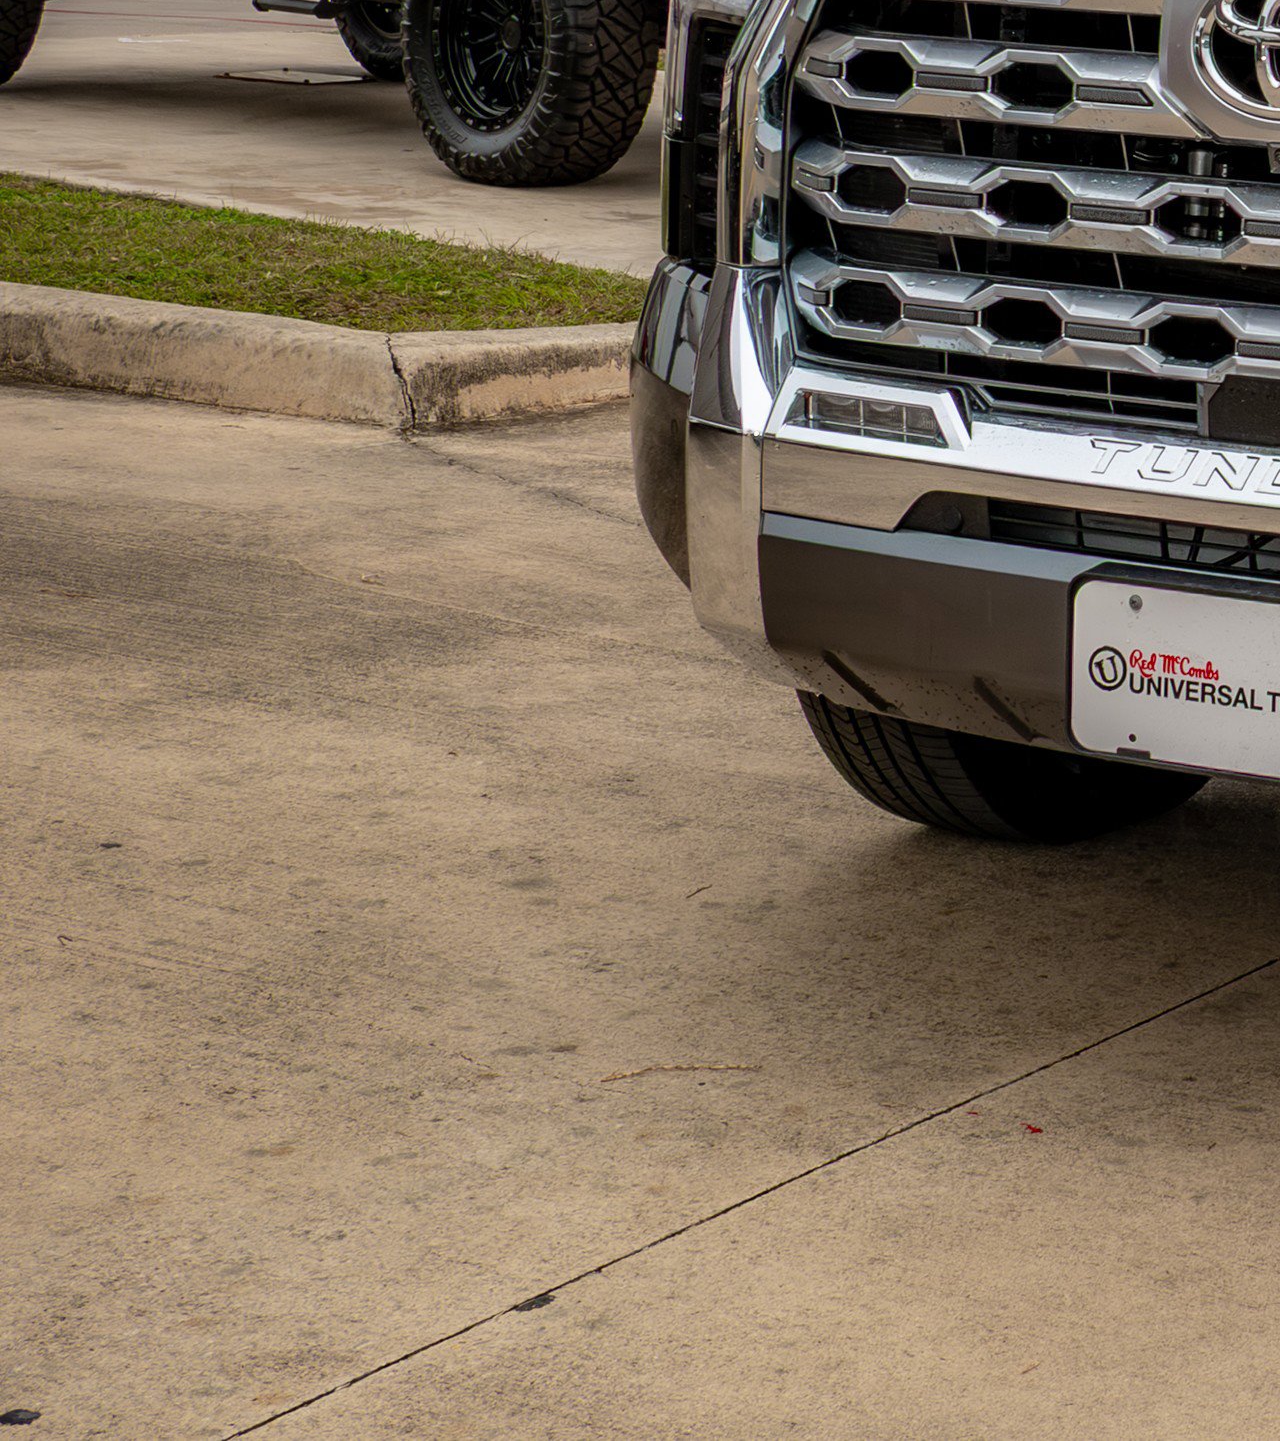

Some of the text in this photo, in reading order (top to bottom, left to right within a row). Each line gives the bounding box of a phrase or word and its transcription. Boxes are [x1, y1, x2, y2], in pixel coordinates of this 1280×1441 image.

[1129, 649, 1220, 681] Red McCombs
[1129, 674, 1263, 711] UNIVERSAL
